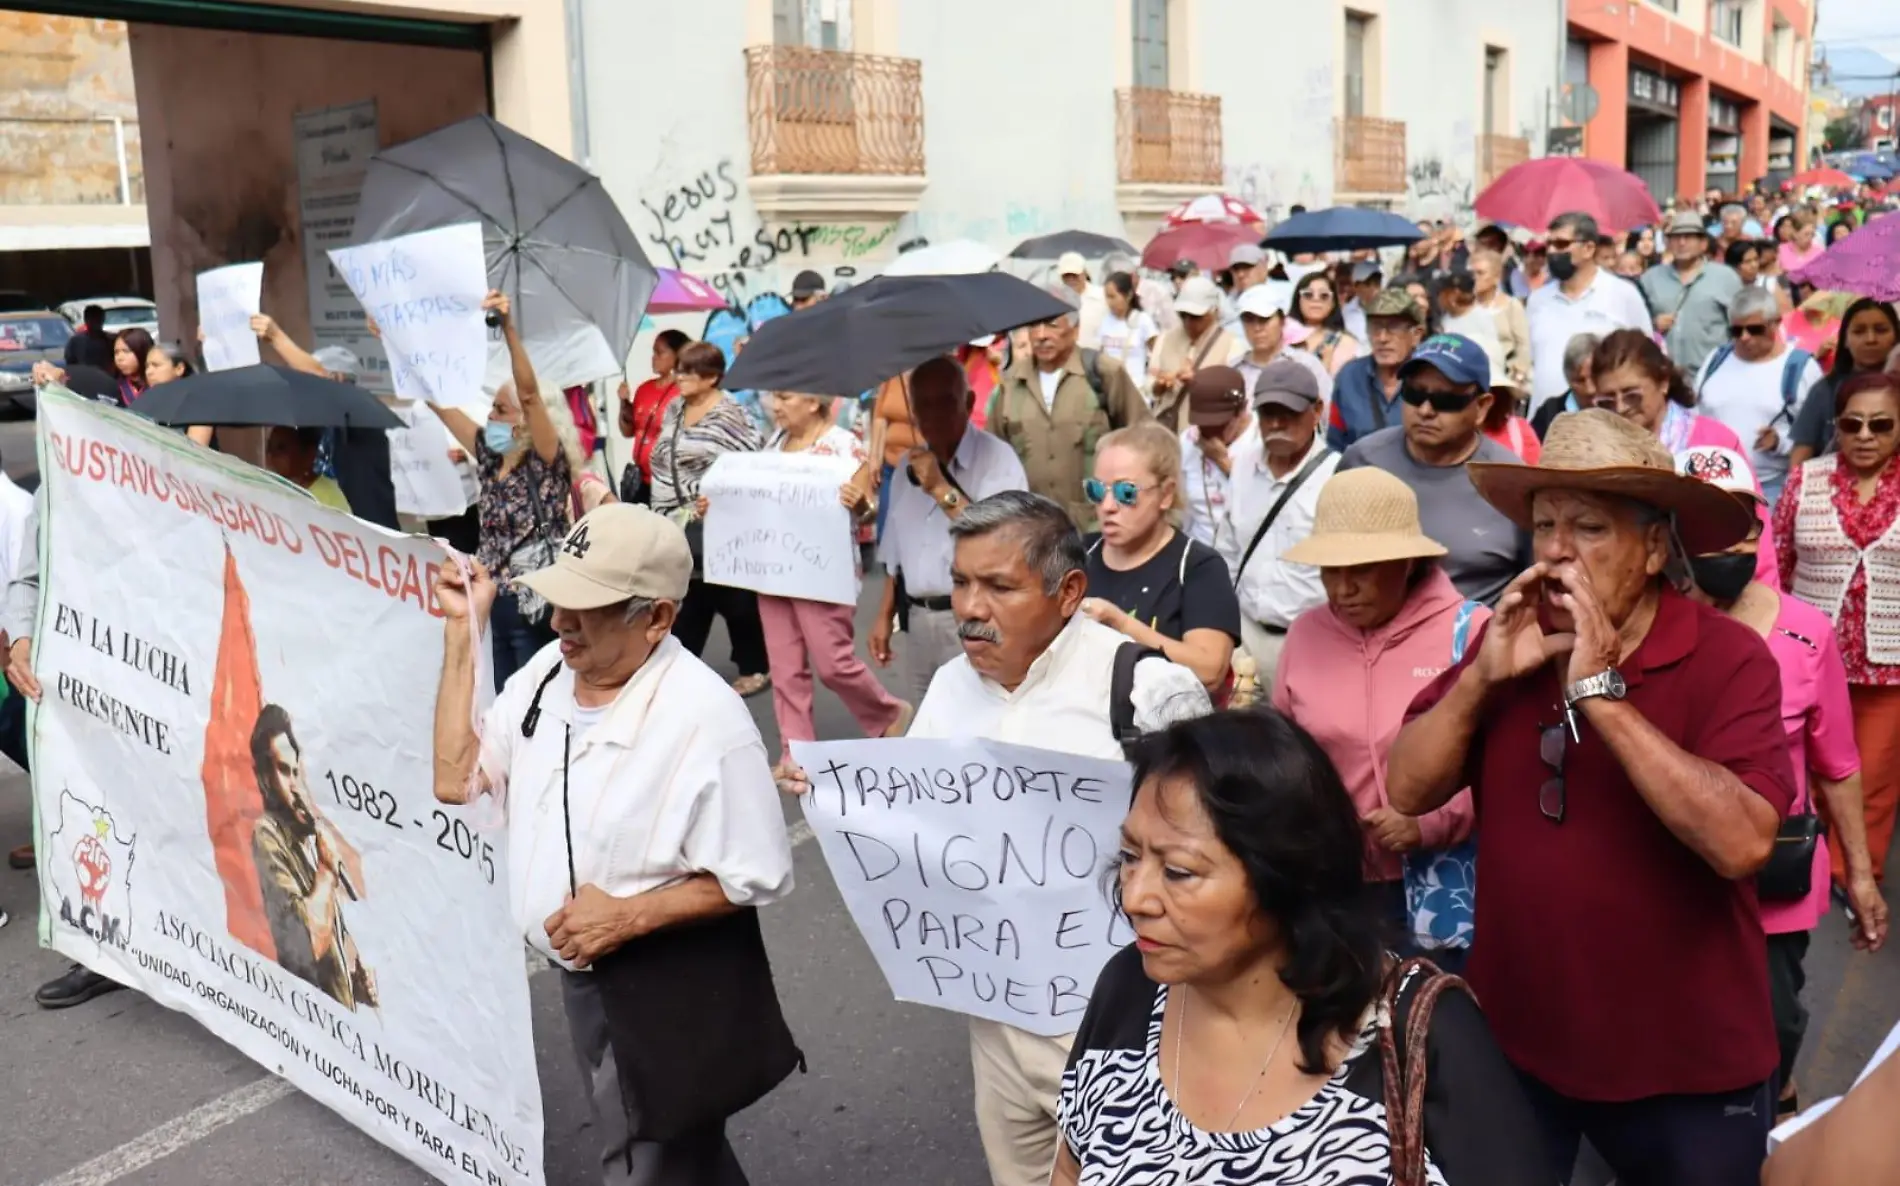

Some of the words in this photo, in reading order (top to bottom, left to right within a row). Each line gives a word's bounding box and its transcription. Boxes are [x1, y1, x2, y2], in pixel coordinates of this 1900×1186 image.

[51, 431, 171, 503] GUSTAVO
[166, 471, 303, 555] SALGADO
[308, 523, 448, 618] DELGAD
[55, 602, 83, 641] EN
[90, 616, 114, 657] LA
[122, 631, 191, 696] LUCHA
[57, 671, 171, 755] PRESENTE
[325, 769, 403, 829] 1982
[432, 809, 495, 885] 2015
[819, 759, 1109, 817] TRANSPORTE
[836, 815, 1098, 891] DIGNO
[882, 898, 1021, 960] PARA
[916, 956, 1090, 1017] PUEB
[154, 909, 286, 1005] ASOCIACIÓN
[291, 989, 367, 1063] CÍVICA
[373, 1043, 530, 1178] MORELENSE
[196, 980, 300, 1057] ORGANIZACIÓN
[302, 1045, 312, 1063] Y
[314, 1052, 363, 1101] LUCHA
[366, 1088, 398, 1125] POR
[400, 1111, 411, 1132] Y
[415, 1121, 457, 1166] PARA
[461, 1152, 484, 1180] EL
